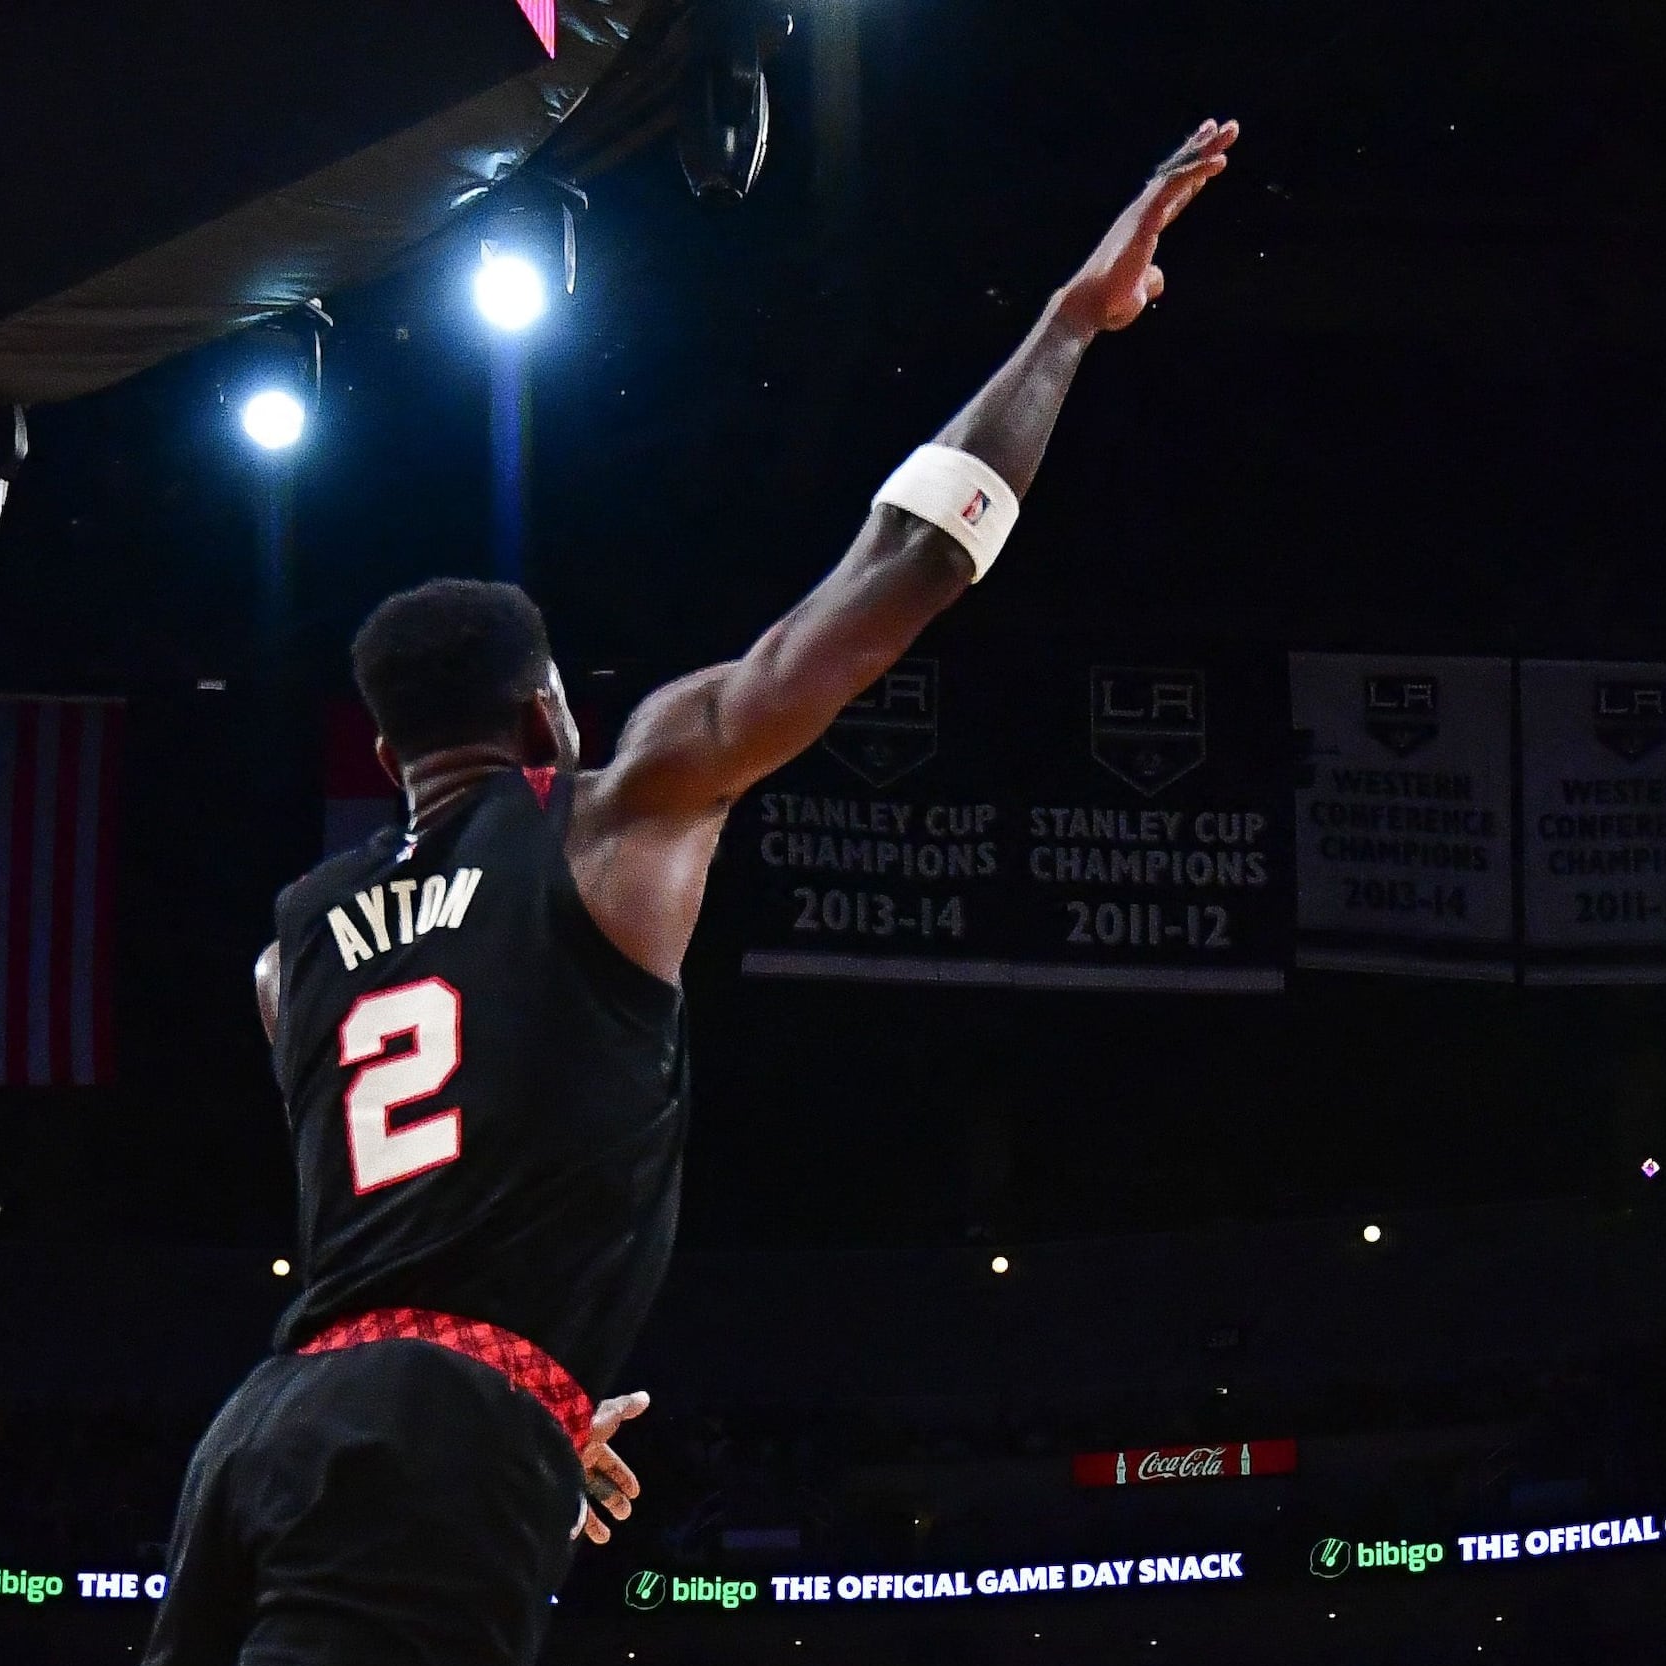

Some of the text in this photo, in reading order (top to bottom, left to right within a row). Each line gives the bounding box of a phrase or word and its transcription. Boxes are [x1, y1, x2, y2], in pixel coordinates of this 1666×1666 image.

[760, 793, 997, 841] STANLEY CUP
[1030, 806, 1266, 846] STANLEY CUP
[759, 831, 998, 878] CHAMPIONS
[1029, 846, 1269, 888] CHAMPIONS
[327, 867, 483, 971] AYTON
[793, 886, 966, 940] 2013-14
[1064, 900, 1232, 950] 2011-12
[338, 973, 463, 1196] 2
[1358, 1540, 1443, 1572] bibigo
[1458, 1534, 1519, 1561] THE
[1525, 1516, 1660, 1555] OFFICIAL
[77, 1573, 138, 1598] THE
[673, 1577, 756, 1608] bibigo
[771, 1553, 1243, 1600] THE OFFICIAL GAME DAY SNACK
